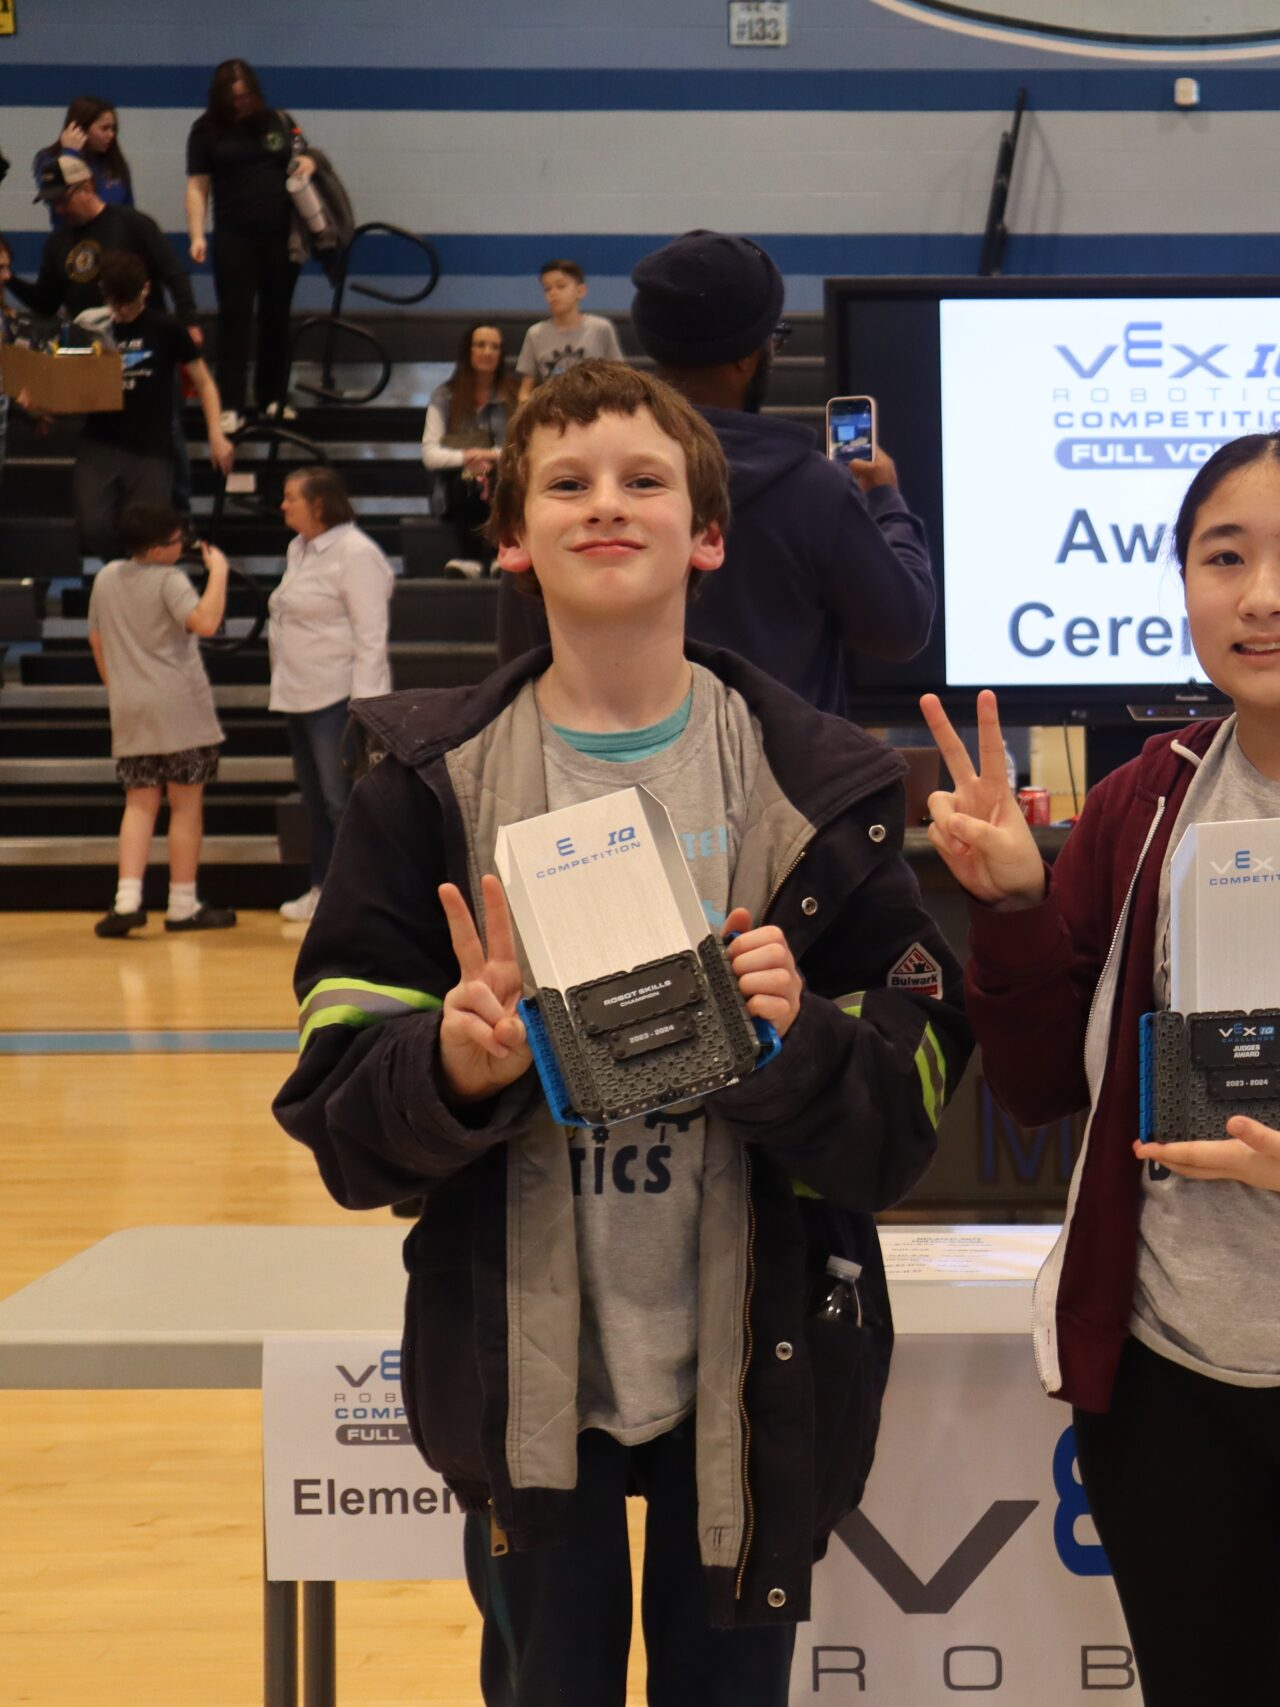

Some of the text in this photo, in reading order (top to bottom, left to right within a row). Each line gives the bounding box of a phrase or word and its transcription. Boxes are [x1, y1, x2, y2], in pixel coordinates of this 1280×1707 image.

[1053, 321, 1231, 379] VEX
[1071, 444, 1154, 463] FULL
[607, 826, 637, 847] IQ
[536, 841, 641, 879] COMPETITION
[1209, 850, 1275, 875] VEX
[891, 974, 937, 986] Bulwark
[603, 979, 672, 1006] ROBOT SKILLS
[620, 991, 660, 1007] CHAMPION
[629, 1032, 649, 1043] 2023
[654, 1024, 675, 1035] 2024
[1218, 1023, 1256, 1038] VEX
[1233, 1044, 1260, 1052] JUDGES
[1249, 1079, 1269, 1087] 2024
[347, 1429, 400, 1441] FULL
